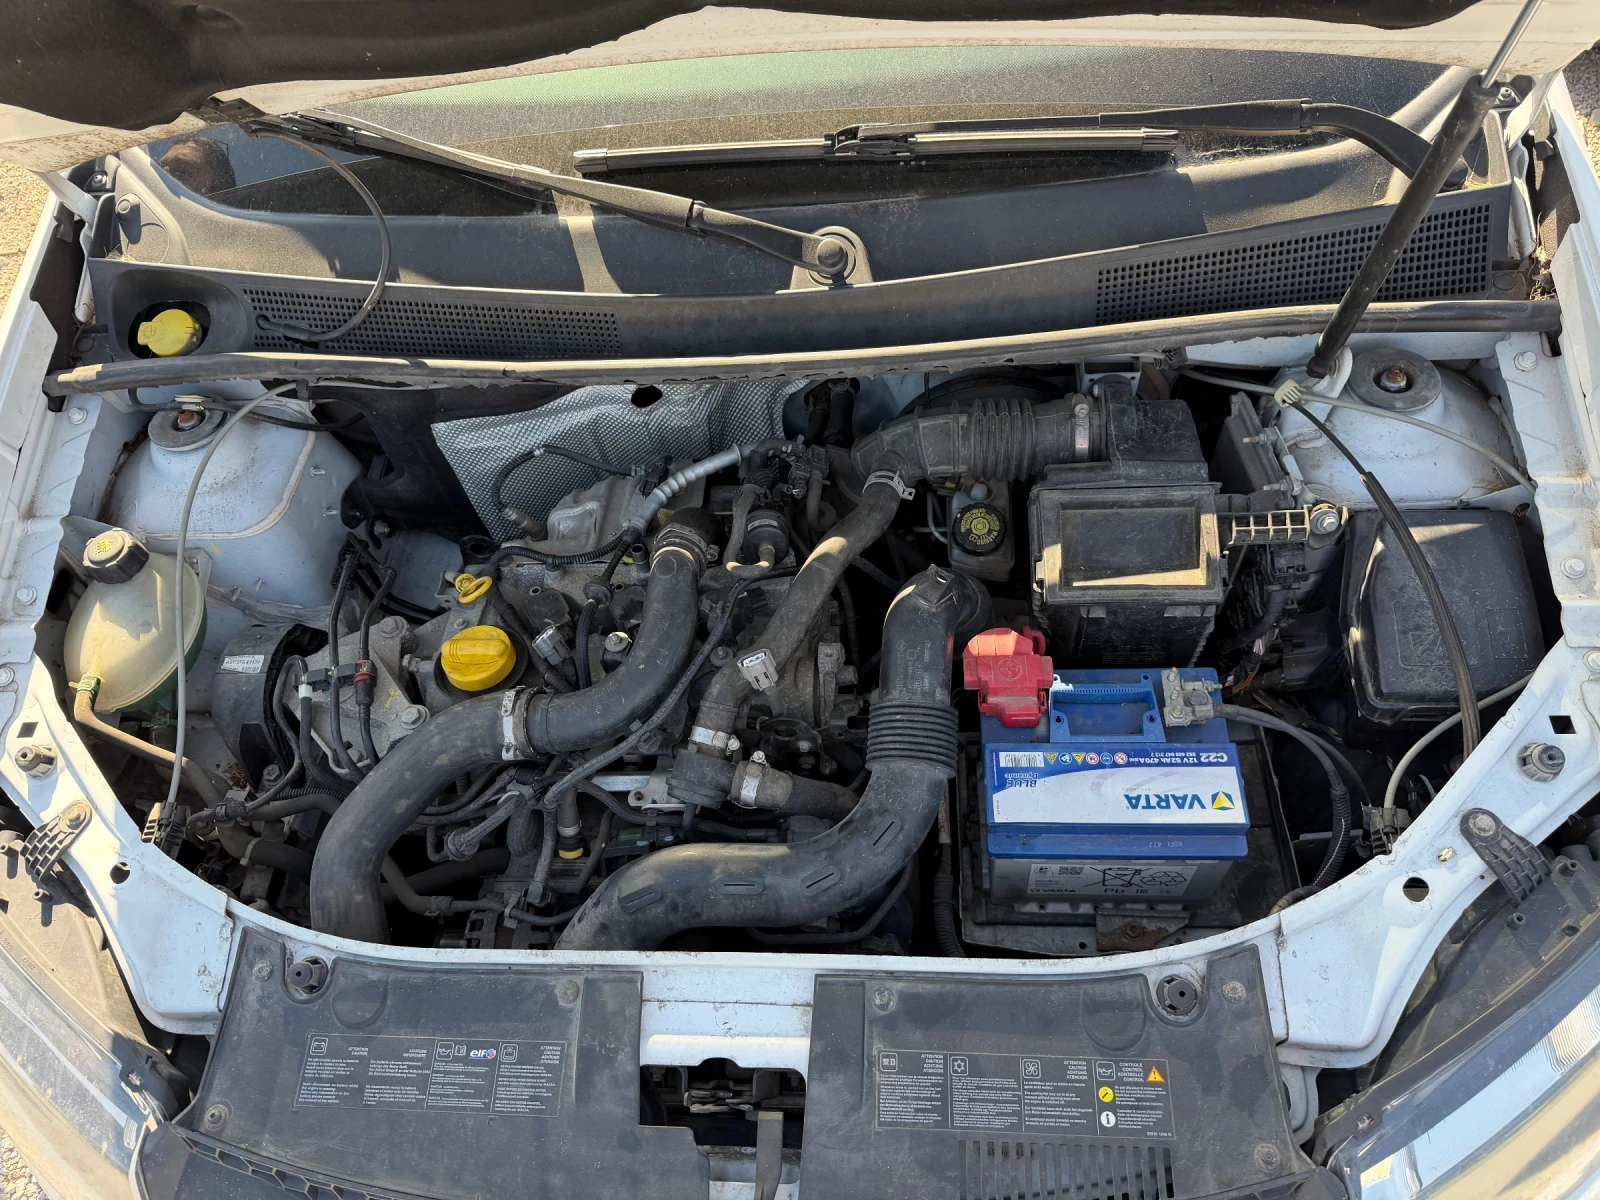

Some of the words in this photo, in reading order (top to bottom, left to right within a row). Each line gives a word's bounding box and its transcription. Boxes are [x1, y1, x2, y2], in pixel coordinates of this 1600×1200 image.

[1199, 752, 1228, 763] C22
[1004, 772, 1039, 780] Dynamic
[1005, 778, 1038, 789] BLUE
[1123, 794, 1207, 810] VARTA
